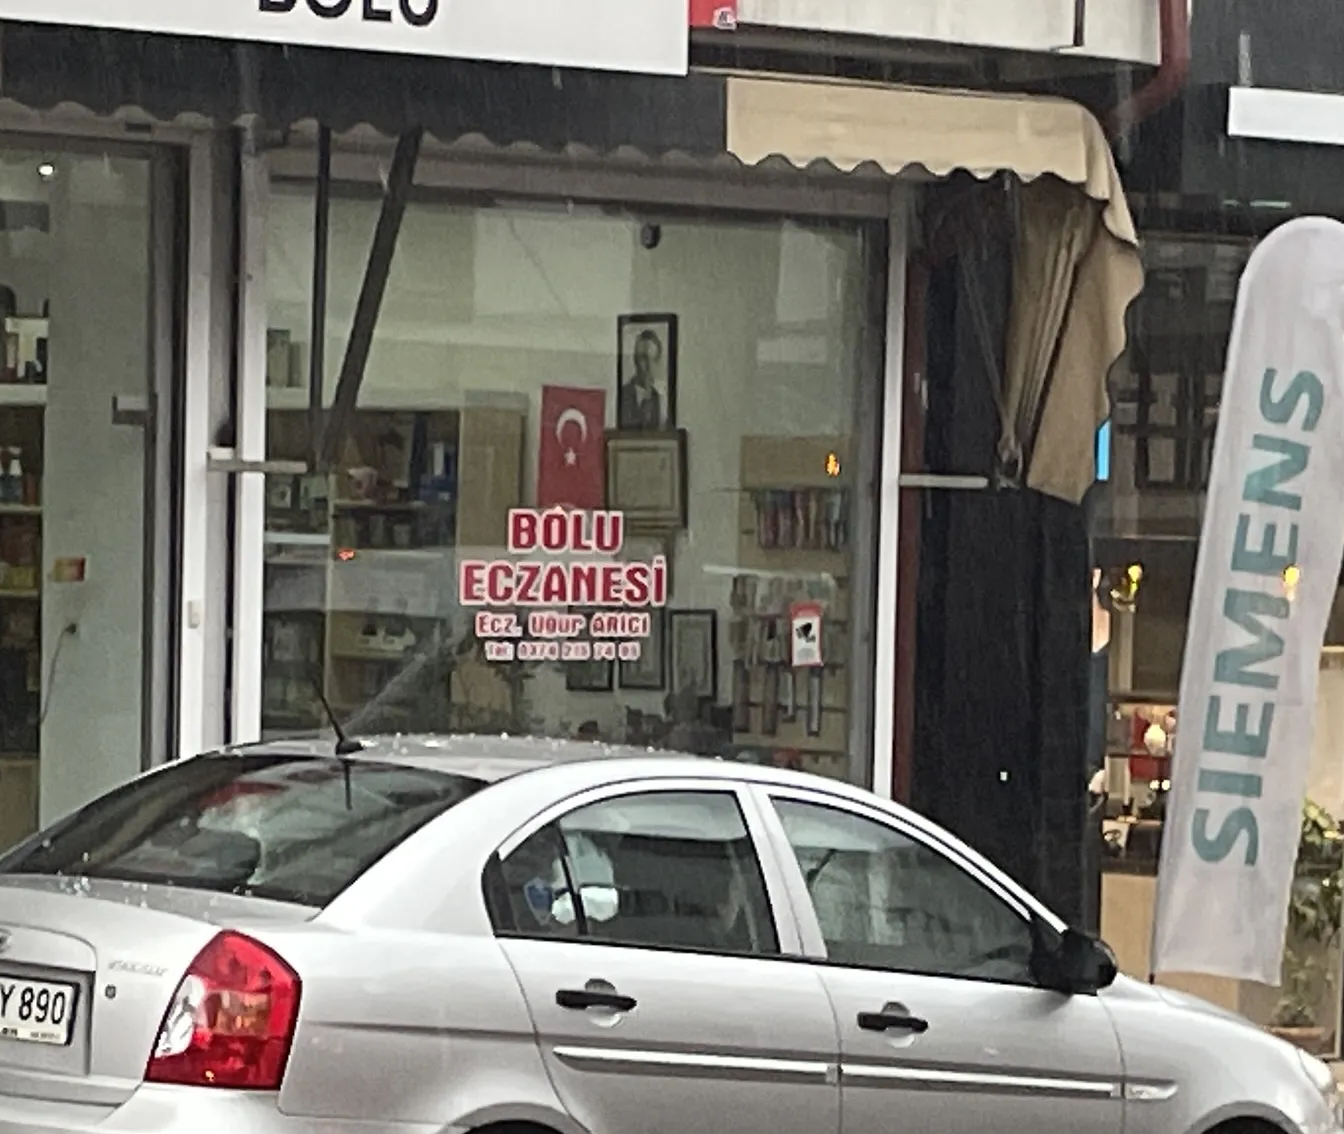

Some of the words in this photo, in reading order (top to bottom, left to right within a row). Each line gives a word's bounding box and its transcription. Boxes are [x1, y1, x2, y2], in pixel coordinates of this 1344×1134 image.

[510, 507, 622, 553] BOLU
[460, 556, 666, 605] ECZANESİ
[1191, 367, 1325, 868] SIEMENS
[18, 986, 66, 1026] 890
